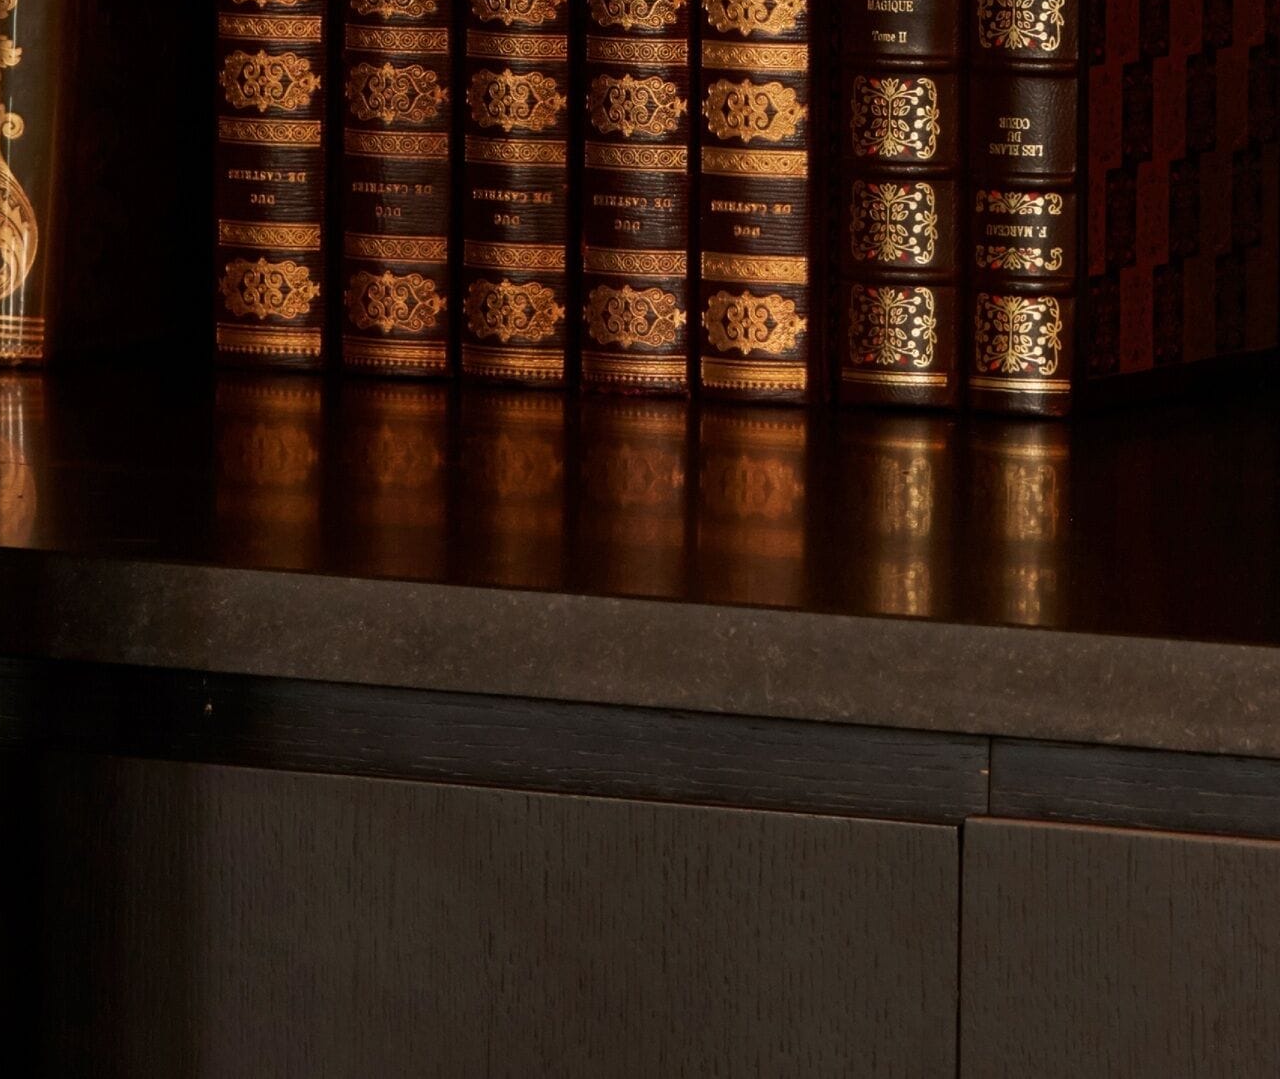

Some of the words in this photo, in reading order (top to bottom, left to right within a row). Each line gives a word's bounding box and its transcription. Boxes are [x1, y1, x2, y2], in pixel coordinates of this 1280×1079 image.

[867, 0, 914, 13] MAGIQUE
[872, 30, 896, 42] Tome
[898, 31, 908, 43] II
[1007, 131, 1022, 143] DU
[1022, 144, 1044, 157] LES
[288, 171, 306, 183] DE
[414, 184, 432, 194] DE
[250, 193, 275, 205] DUC
[533, 191, 552, 204] DE
[653, 196, 672, 209] DE
[375, 205, 401, 217] DUC
[773, 203, 793, 215] DE
[494, 213, 520, 225] DUC
[614, 219, 640, 230] DUC
[733, 224, 761, 238] DUC
[986, 223, 1033, 238] MARCEAU
[1036, 226, 1047, 238] F.
